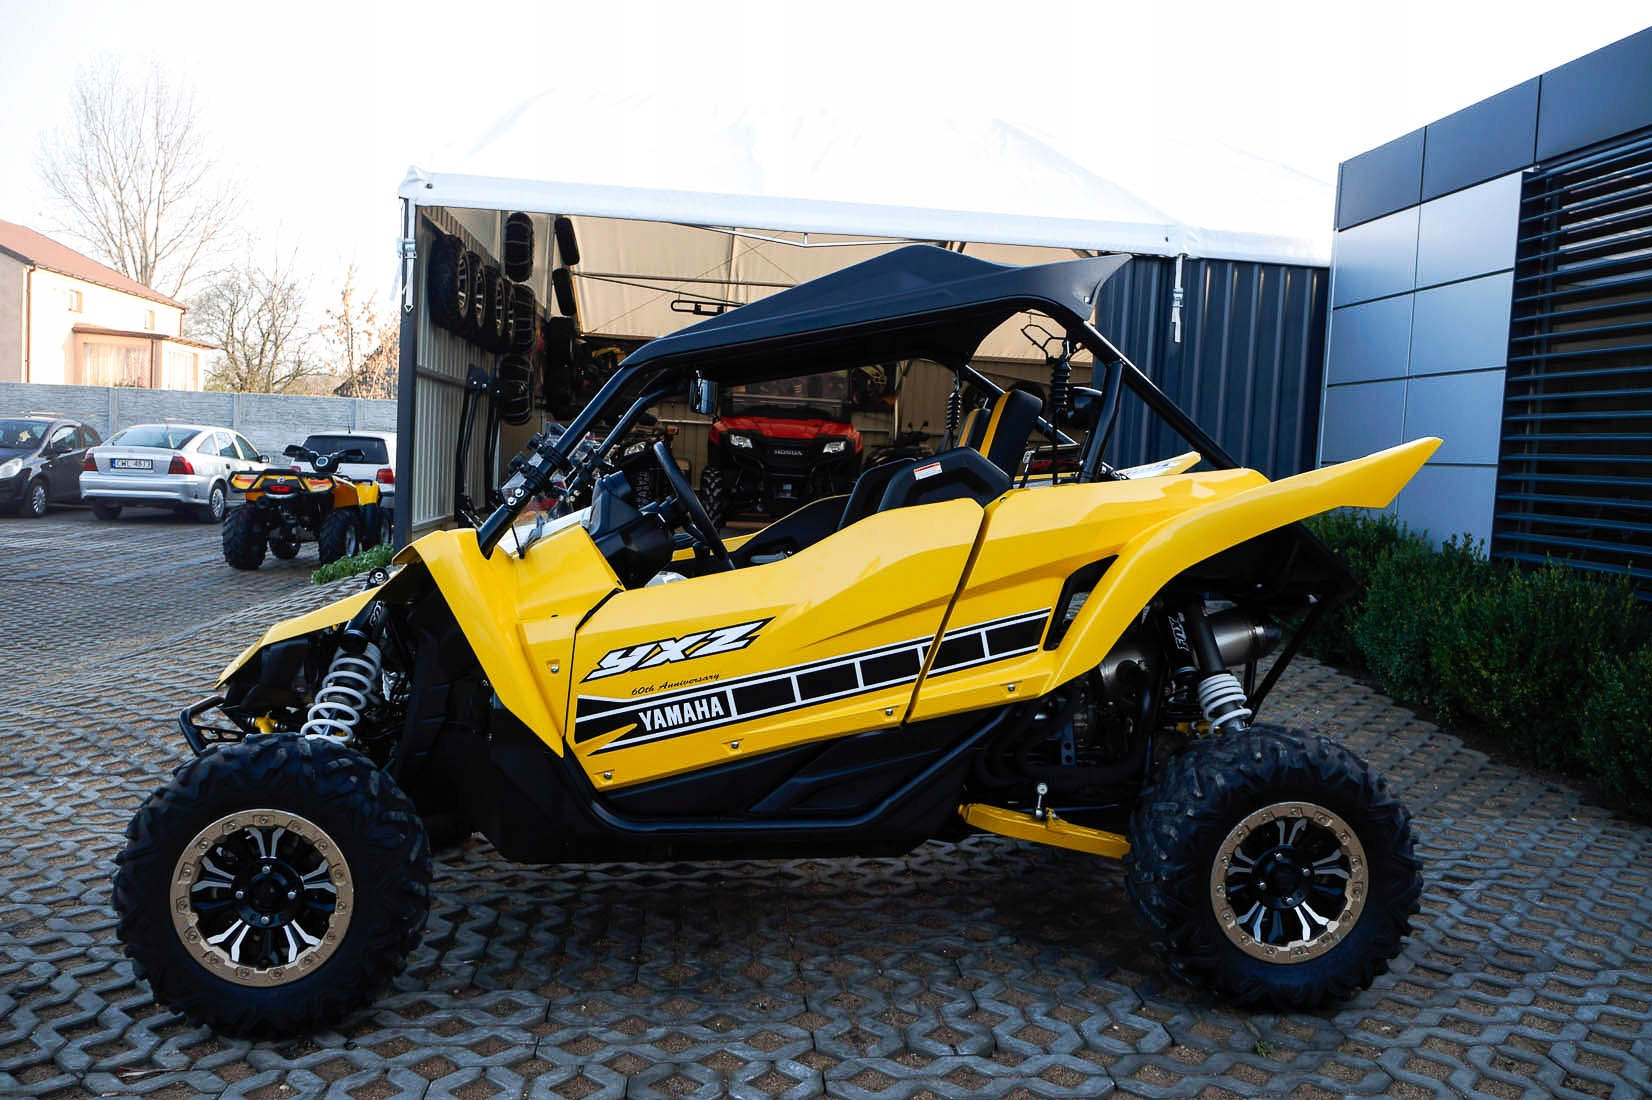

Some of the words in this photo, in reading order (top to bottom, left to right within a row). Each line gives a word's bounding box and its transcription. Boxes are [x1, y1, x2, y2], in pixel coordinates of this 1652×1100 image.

[580, 617, 775, 683] YXZ
[631, 684, 654, 696] 60th
[658, 672, 720, 690] Anniversary
[638, 696, 724, 732] YAMAHA
